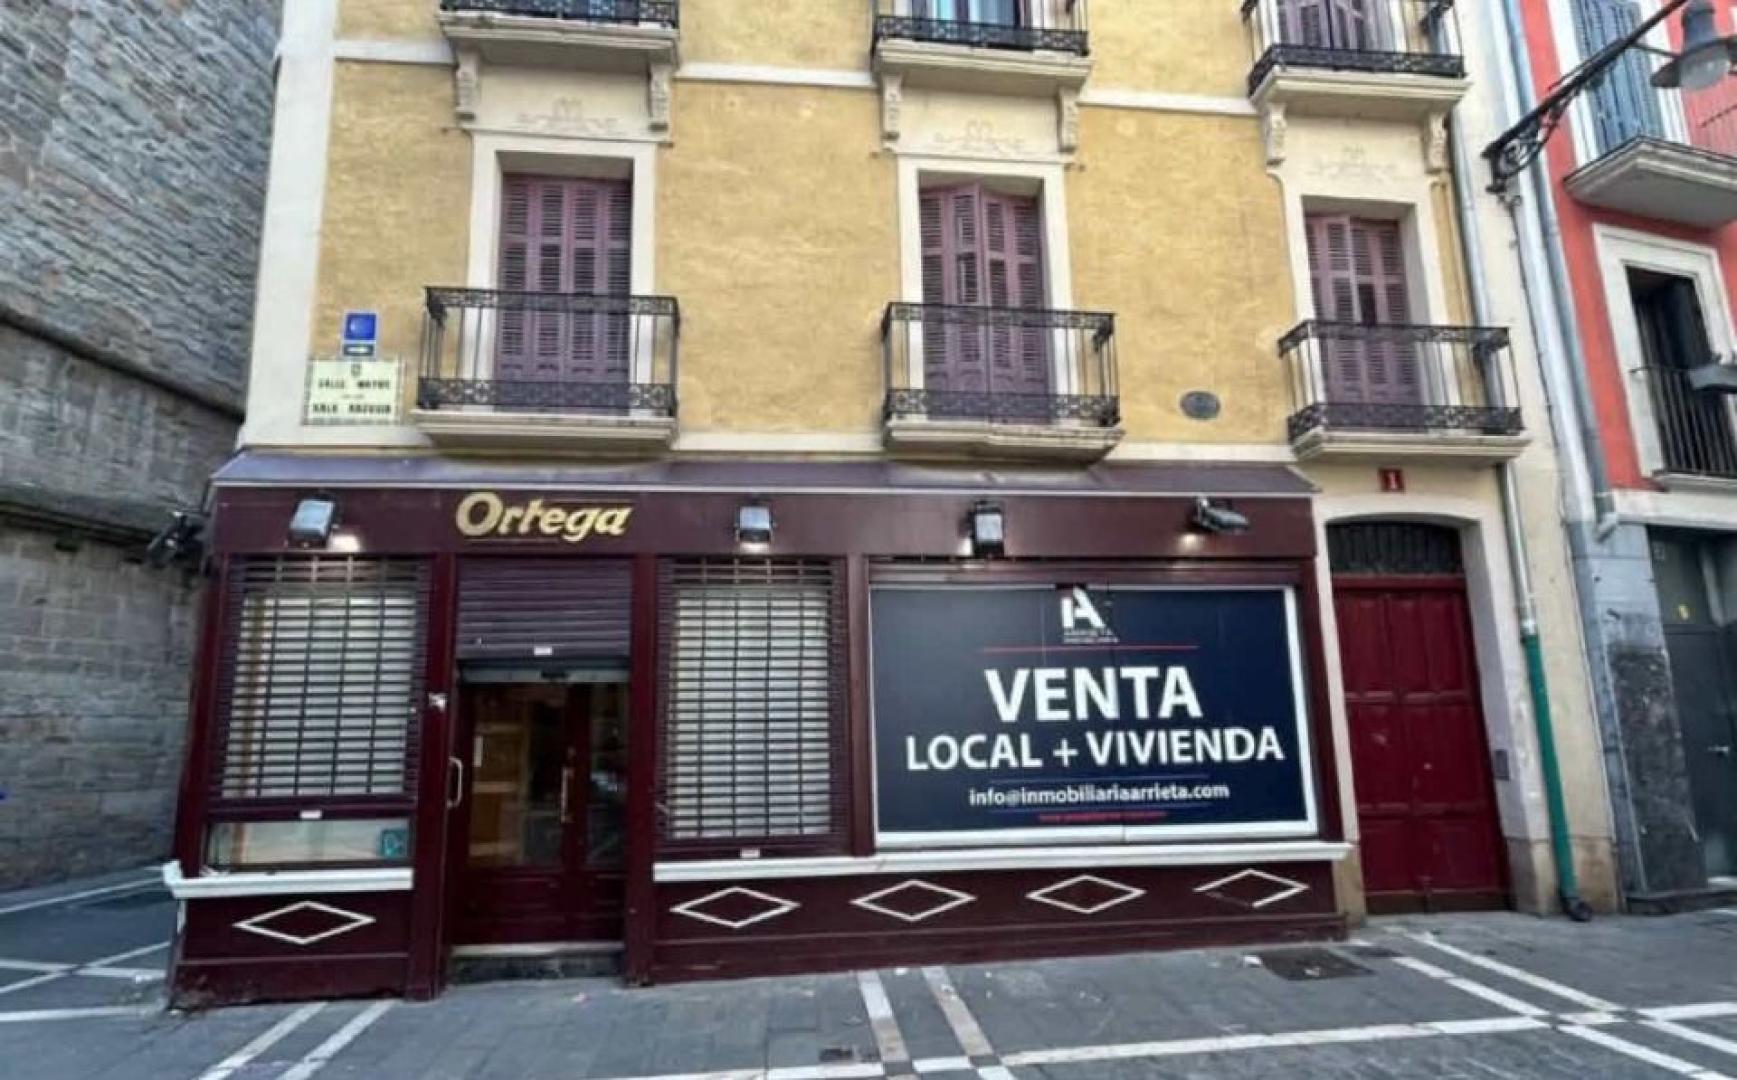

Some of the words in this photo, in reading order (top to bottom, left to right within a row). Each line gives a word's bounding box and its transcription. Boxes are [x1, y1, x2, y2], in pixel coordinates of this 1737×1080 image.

[456, 491, 632, 542] Ortega
[985, 667, 1203, 722] VENTA
[907, 735, 1042, 770] LOCAL
[1054, 739, 1078, 767] +
[1086, 727, 1283, 766] VIVIENDA
[969, 784, 1230, 807] info@inmobiliariaarrieta.com
